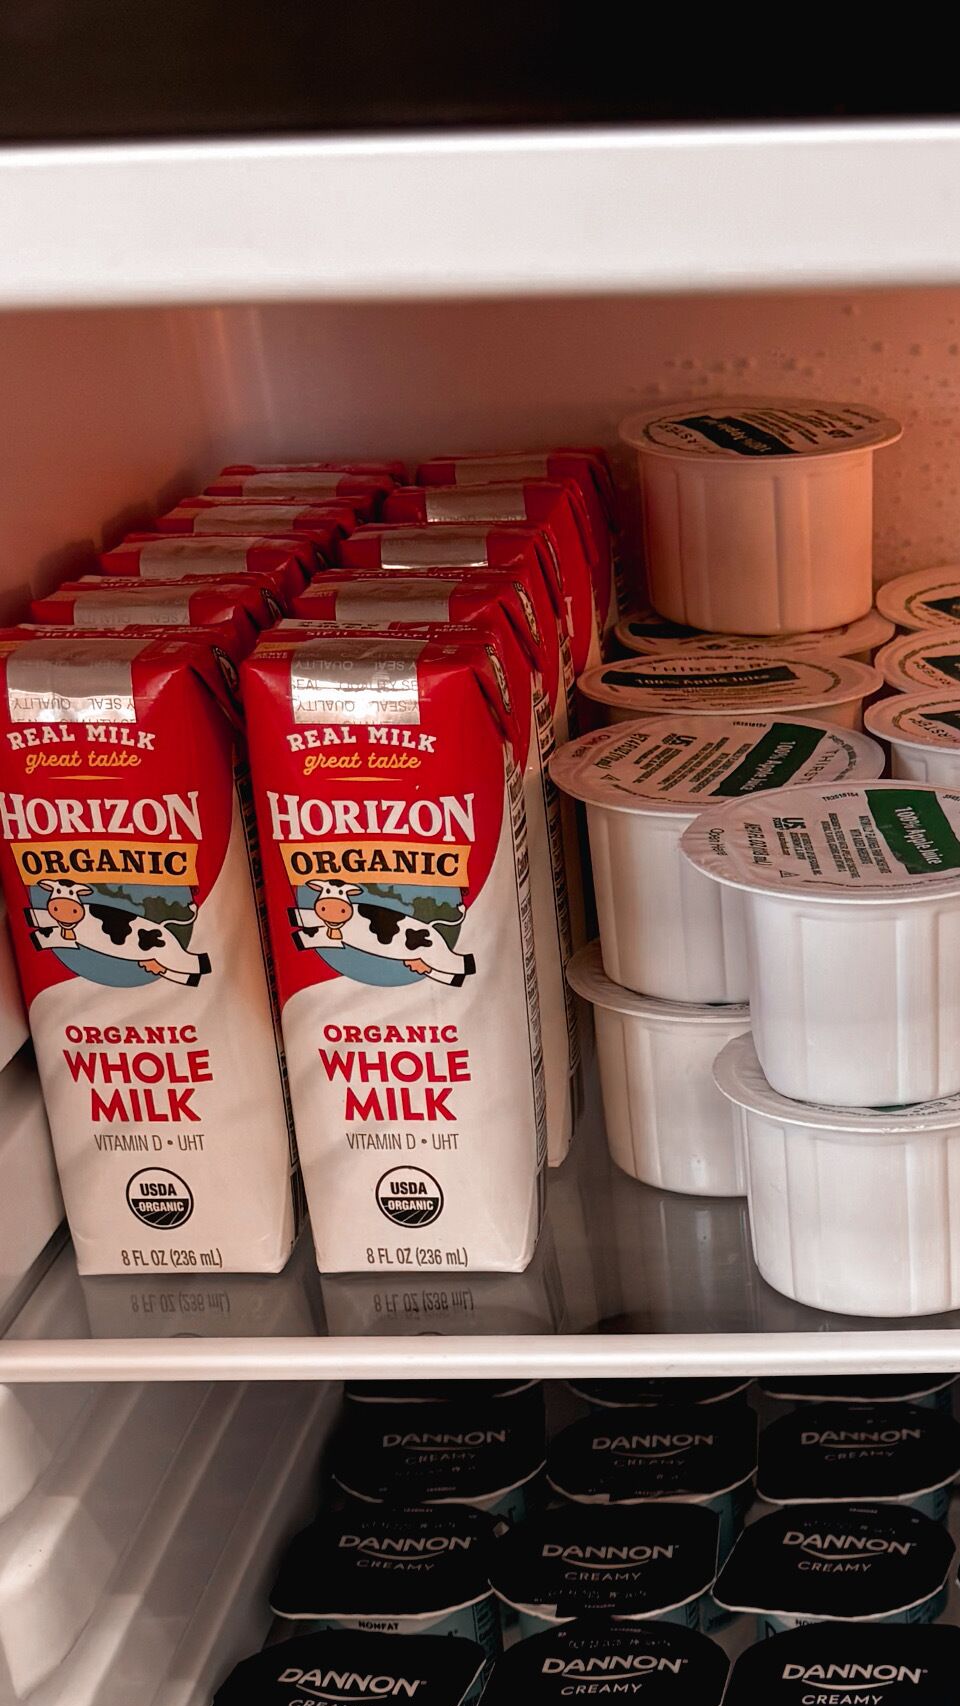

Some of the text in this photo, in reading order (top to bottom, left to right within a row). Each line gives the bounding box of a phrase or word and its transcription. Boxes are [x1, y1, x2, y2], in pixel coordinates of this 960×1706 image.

[14, 698, 122, 710] SEAL QUALITY
[297, 700, 355, 711] QUALITY
[7, 724, 155, 750] REAL MILK
[287, 727, 437, 753] REAL MILK
[25, 750, 141, 774] great taste
[303, 753, 421, 776] great taste
[0, 791, 202, 840] HORIZON
[267, 791, 475, 842] HORIZON
[895, 806, 943, 865] 100% Apple Juice
[22, 849, 187, 876] ORGANIC
[291, 849, 459, 876] ORGANIC
[65, 1025, 198, 1044] ORGANIC
[323, 1025, 458, 1043] ORGANIC
[63, 1049, 213, 1084] WHOLE
[318, 1048, 471, 1083] WHOLE
[91, 1088, 202, 1122] MILK
[345, 1087, 457, 1121] MILK
[94, 1134, 205, 1151] VITAMIN D UHT
[346, 1133, 459, 1150] VITAMIN D UHT
[140, 1183, 177, 1196] USDA
[390, 1182, 428, 1195] USDA
[138, 1201, 185, 1212] ORGANIC
[387, 1200, 433, 1211] ORGANIC
[122, 1249, 223, 1268] 8 FL OZ (236 mL)
[366, 1247, 469, 1267] 8 FL OZ (236 mL)
[382, 1430, 507, 1448] DANNON
[592, 1433, 714, 1450] DANNON
[800, 1428, 922, 1445] DANNON
[338, 1535, 473, 1551] DANNON
[541, 1544, 674, 1560] DANNON
[783, 1532, 911, 1555] DANNON
[356, 1559, 436, 1571] CREAMY
[798, 1560, 872, 1572] CREAMY
[565, 1571, 642, 1581] CREAMY
[358, 1620, 399, 1631] NONFAT
[541, 1654, 682, 1675] DANNON
[278, 1668, 420, 1698] DANNON
[782, 1663, 922, 1685] DANNON
[561, 1683, 643, 1696] CREAMY
[801, 1694, 884, 1706] CREAMY
